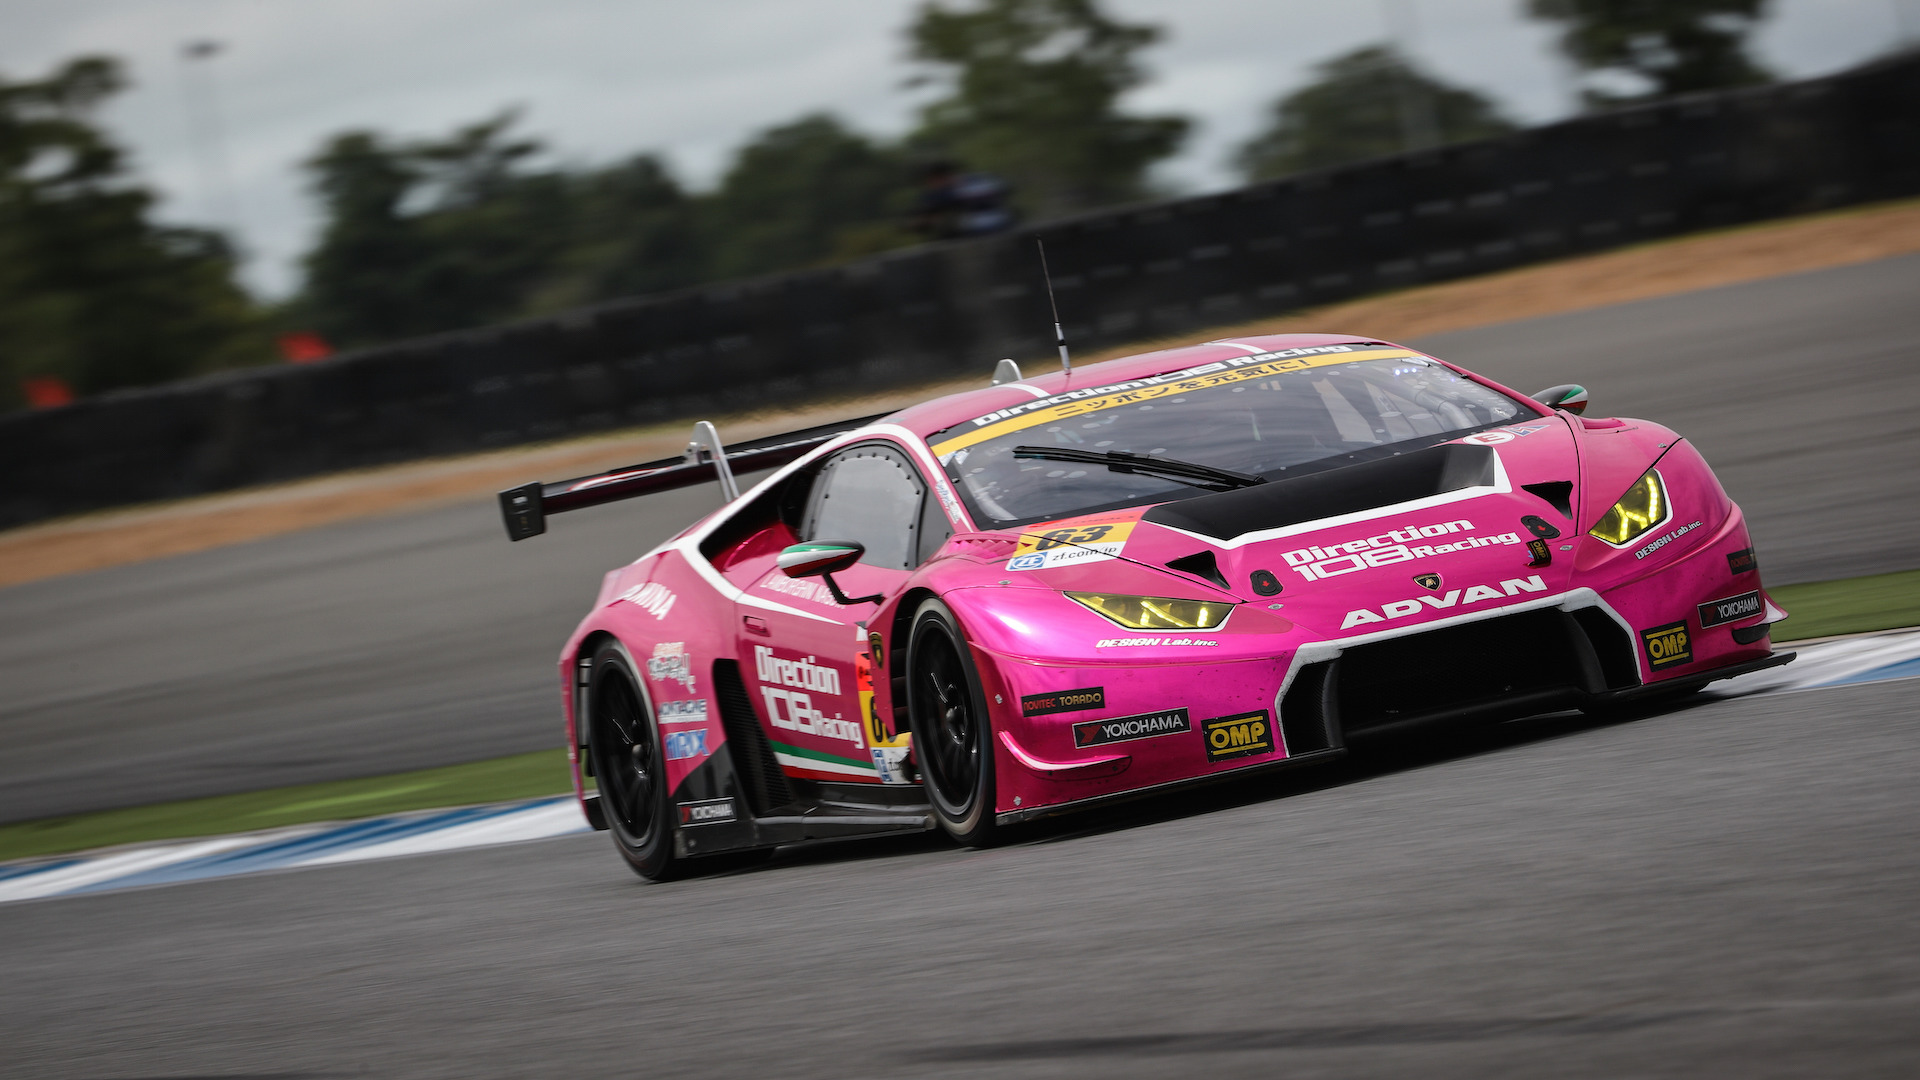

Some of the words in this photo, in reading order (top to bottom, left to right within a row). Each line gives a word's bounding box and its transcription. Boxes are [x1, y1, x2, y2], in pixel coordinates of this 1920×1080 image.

[1228, 344, 1353, 367] Racing
[1035, 525, 1114, 551] 63
[1280, 519, 1476, 567] Direction
[1634, 534, 1673, 560] DESIGN
[1339, 575, 1548, 630] ADVAN
[1717, 596, 1760, 619] YOKOHAMA
[1096, 638, 1161, 648] DESIGN
[1649, 633, 1687, 659] OMP
[754, 645, 841, 695] Direction
[1059, 693, 1101, 706] TORADO
[1102, 714, 1183, 739] YOKOHAMA
[1210, 722, 1265, 748] OMP
